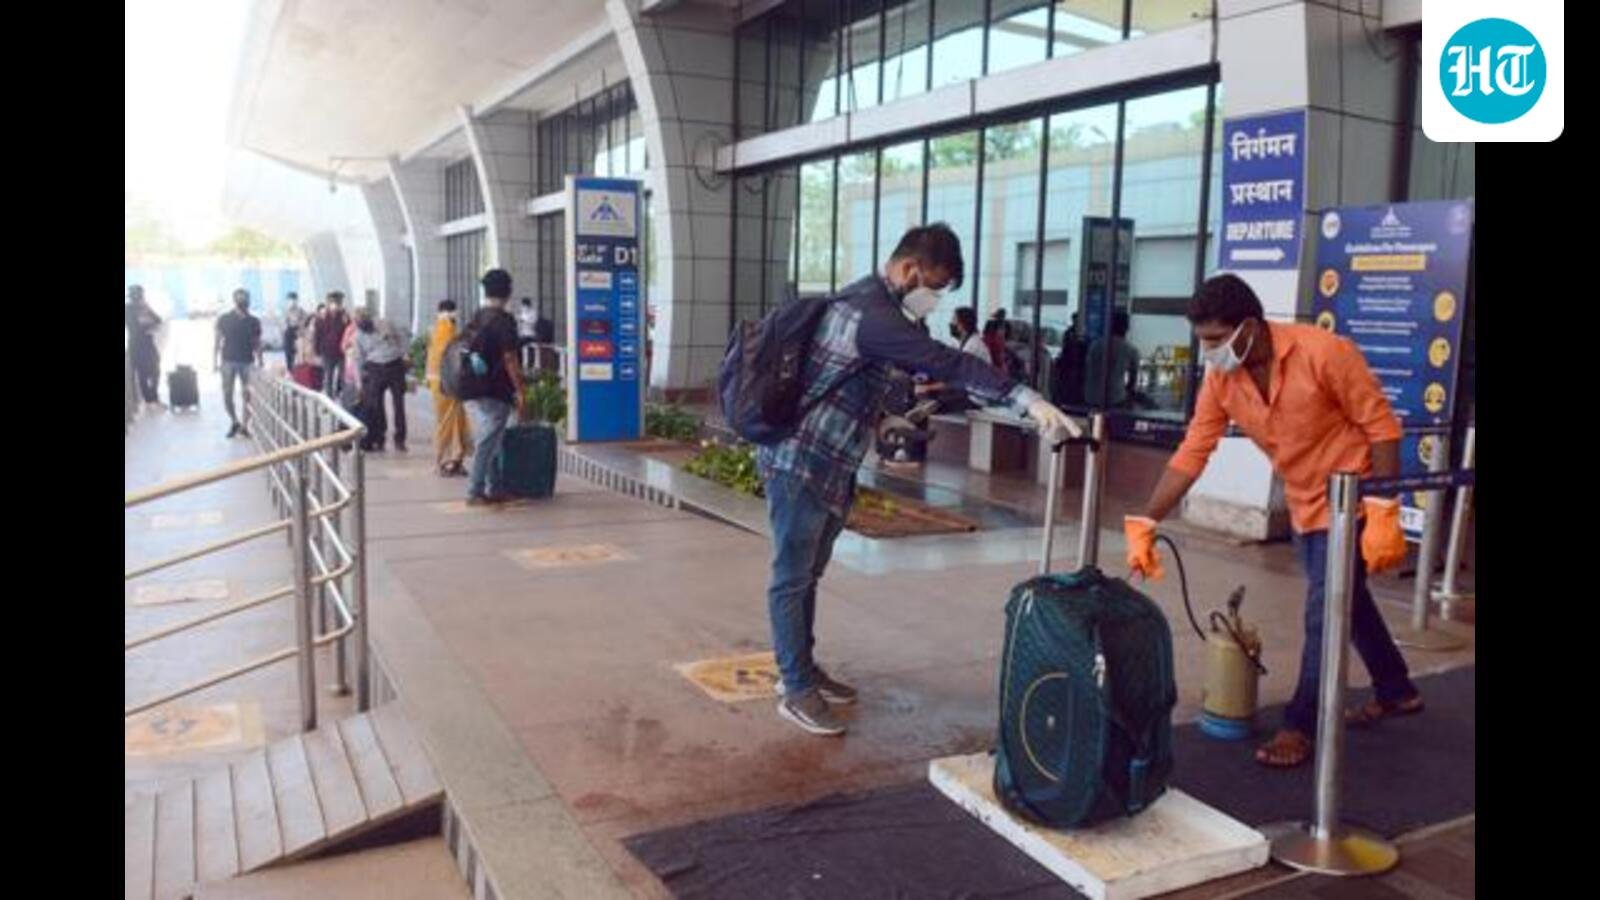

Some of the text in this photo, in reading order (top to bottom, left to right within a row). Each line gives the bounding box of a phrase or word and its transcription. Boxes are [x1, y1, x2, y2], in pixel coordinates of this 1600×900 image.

[1230, 128, 1297, 161] निर्गमन
[1230, 180, 1294, 204] प्रस्थान
[1227, 220, 1294, 241] DEPARTURE
[614, 246, 637, 265] D1
